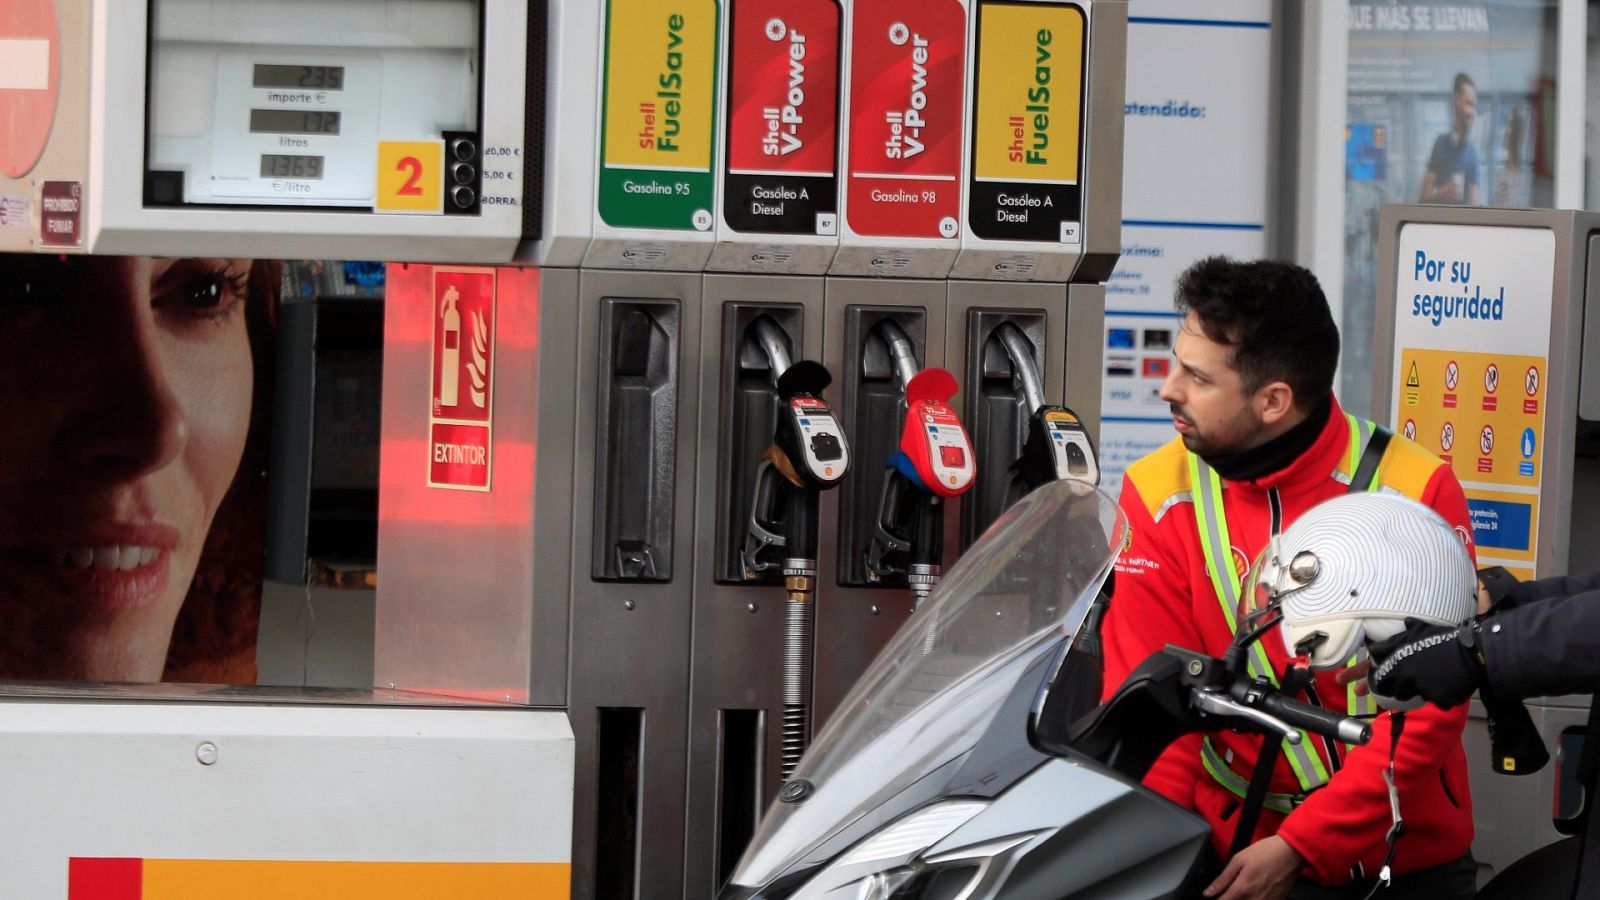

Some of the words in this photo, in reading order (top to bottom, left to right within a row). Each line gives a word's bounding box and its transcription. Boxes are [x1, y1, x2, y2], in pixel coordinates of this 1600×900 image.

[1413, 7, 1432, 31] SE
[1435, 7, 1489, 31] LLEVAN
[657, 13, 685, 152] FuelSave
[268, 92, 312, 104] importe
[316, 92, 328, 104] €
[781, 29, 806, 156] V-Power
[904, 34, 929, 159] V-Power
[1026, 29, 1053, 165] FuelSave
[639, 103, 656, 150] Shell
[763, 108, 780, 156] Shell
[279, 137, 309, 148] litros
[886, 112, 902, 159] Shell
[1009, 116, 1025, 163] Shell
[514, 148, 521, 156] €
[396, 157, 424, 196] 2
[272, 180, 311, 193] €/litro
[623, 181, 672, 195] Gasolina
[675, 183, 690, 196] 95
[752, 186, 797, 200] Gasóleo
[800, 189, 809, 200] A
[871, 189, 919, 203] Gasolina
[922, 191, 936, 203] 98
[997, 194, 1041, 207] Gasóleo
[1044, 196, 1053, 207] A
[752, 202, 784, 216] Diesel
[698, 216, 707, 224] E5
[997, 210, 1028, 223] Diesel
[48, 220, 74, 233] FUMAR
[822, 220, 831, 228] B7
[944, 223, 953, 231] E5
[1065, 229, 1075, 237] B7
[1414, 250, 1446, 282] Por
[1451, 261, 1471, 284] su
[1412, 285, 1505, 327] seguridad
[433, 443, 486, 466] EXTINTOR
